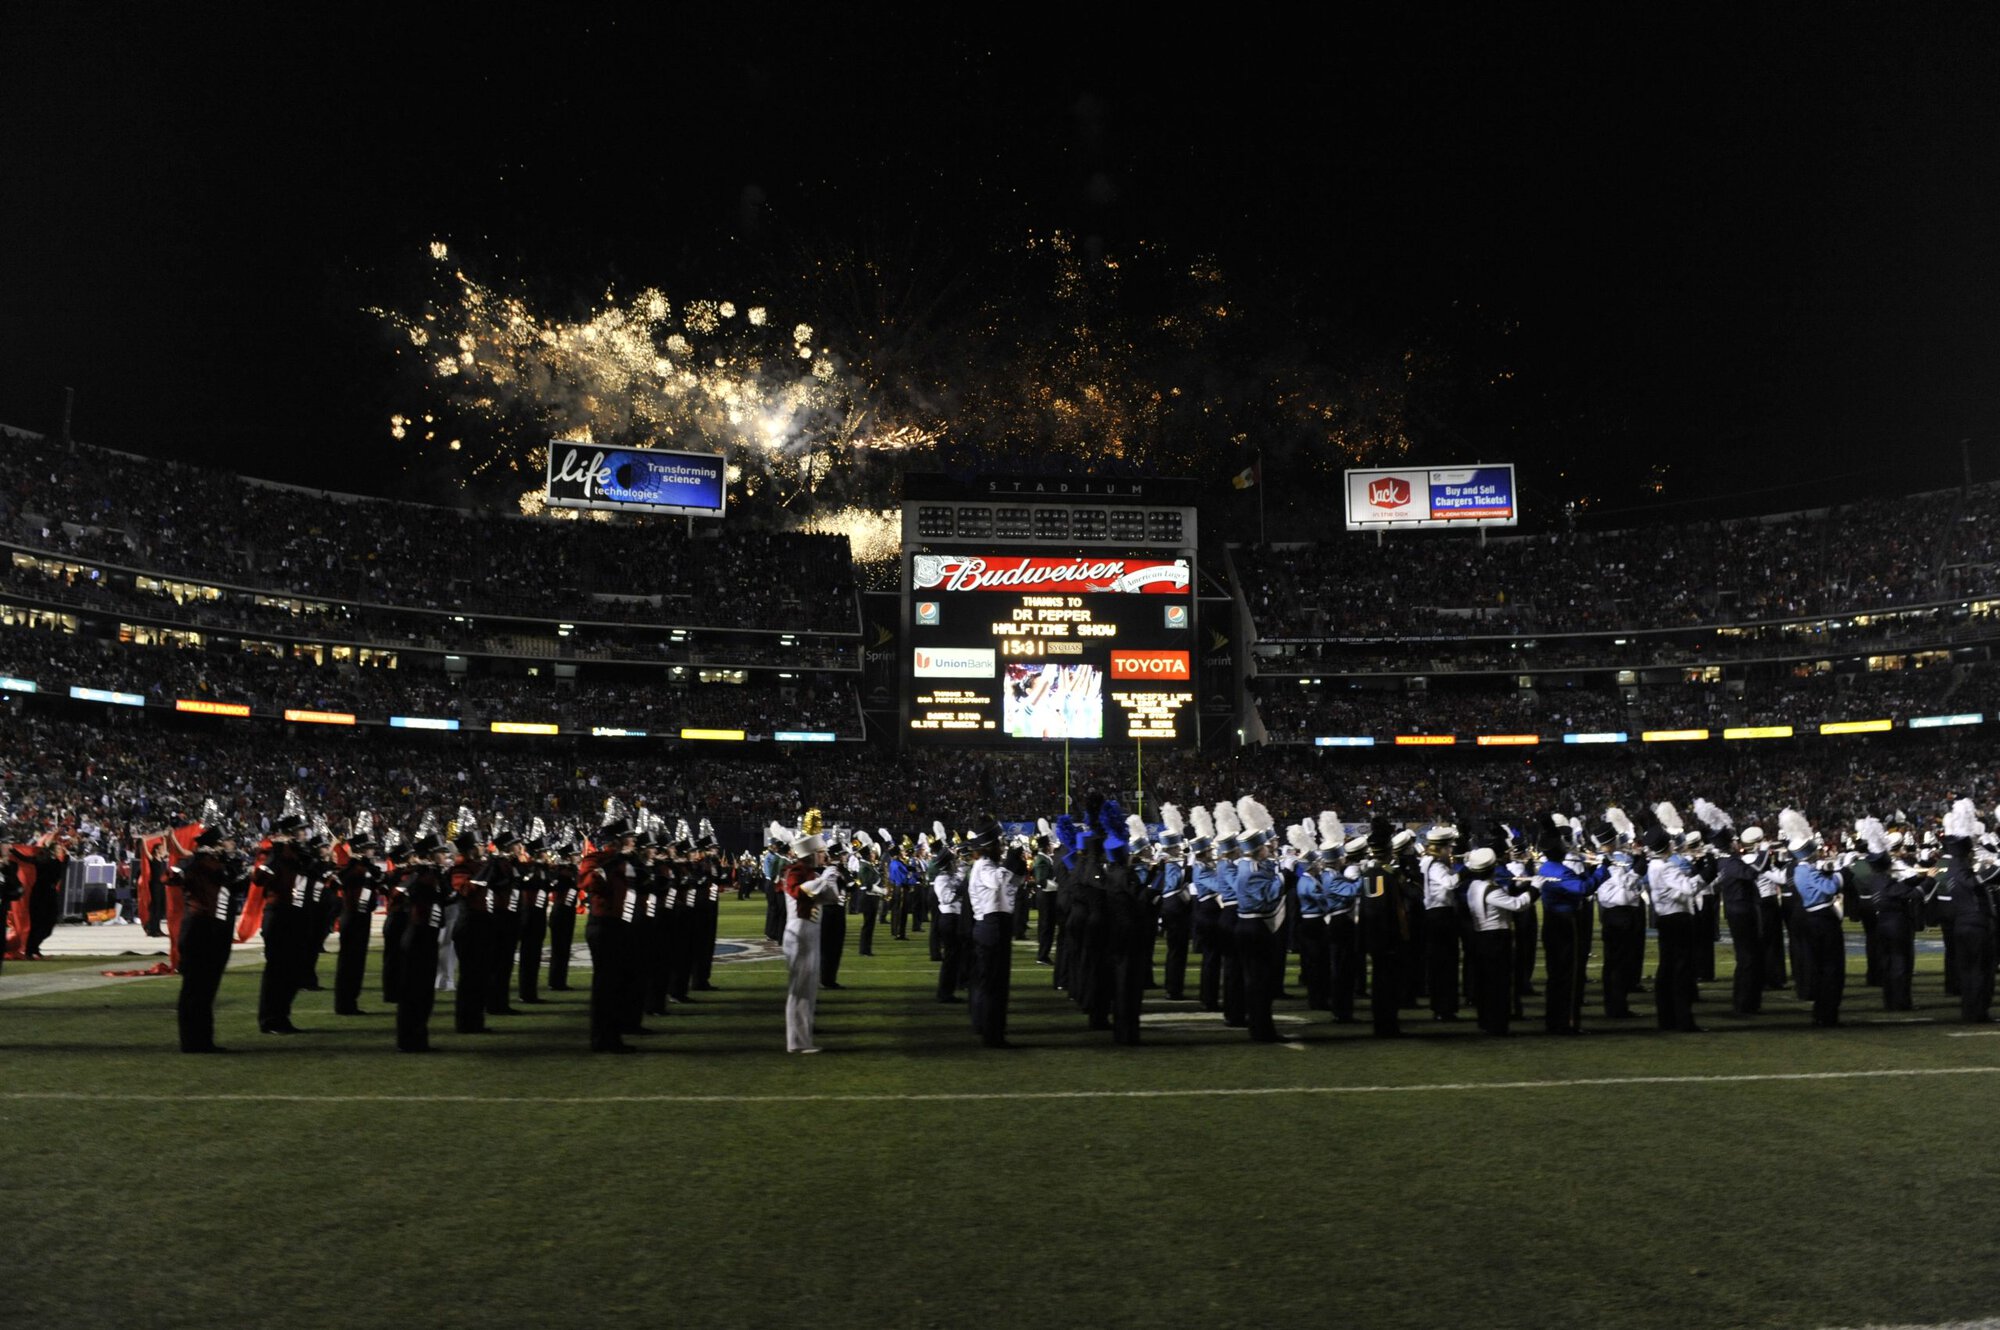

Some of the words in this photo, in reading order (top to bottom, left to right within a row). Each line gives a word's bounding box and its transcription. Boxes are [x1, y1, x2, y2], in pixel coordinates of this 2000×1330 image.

[552, 449, 612, 497] life
[648, 462, 717, 479] Transforming
[662, 474, 701, 485] science
[595, 486, 658, 499] technologies
[989, 482, 1142, 494] STADIUM
[1370, 480, 1409, 504] Jack
[1445, 486, 1460, 496] Buy
[1463, 485, 1478, 495] and
[1480, 484, 1495, 494] Sell
[1435, 496, 1473, 507] Chargers
[1474, 495, 1507, 505] Tickets!
[939, 557, 1125, 591] Budweiser
[1127, 570, 1163, 586] American
[1164, 570, 1187, 580] Lager
[1022, 596, 1064, 607] THANKS
[1067, 597, 1082, 607] TO
[1012, 609, 1033, 621] DR
[1038, 609, 1091, 622] PEPPER
[992, 622, 1069, 636] HALFTIME
[1077, 624, 1116, 636] SHOW
[866, 650, 896, 662] Sprint
[935, 659, 993, 668] UnionBank
[1114, 658, 1187, 673] TOYOTA
[1397, 736, 1425, 744] WELLS
[1426, 736, 1454, 744] FARGO
[1364, 875, 1384, 898] U
